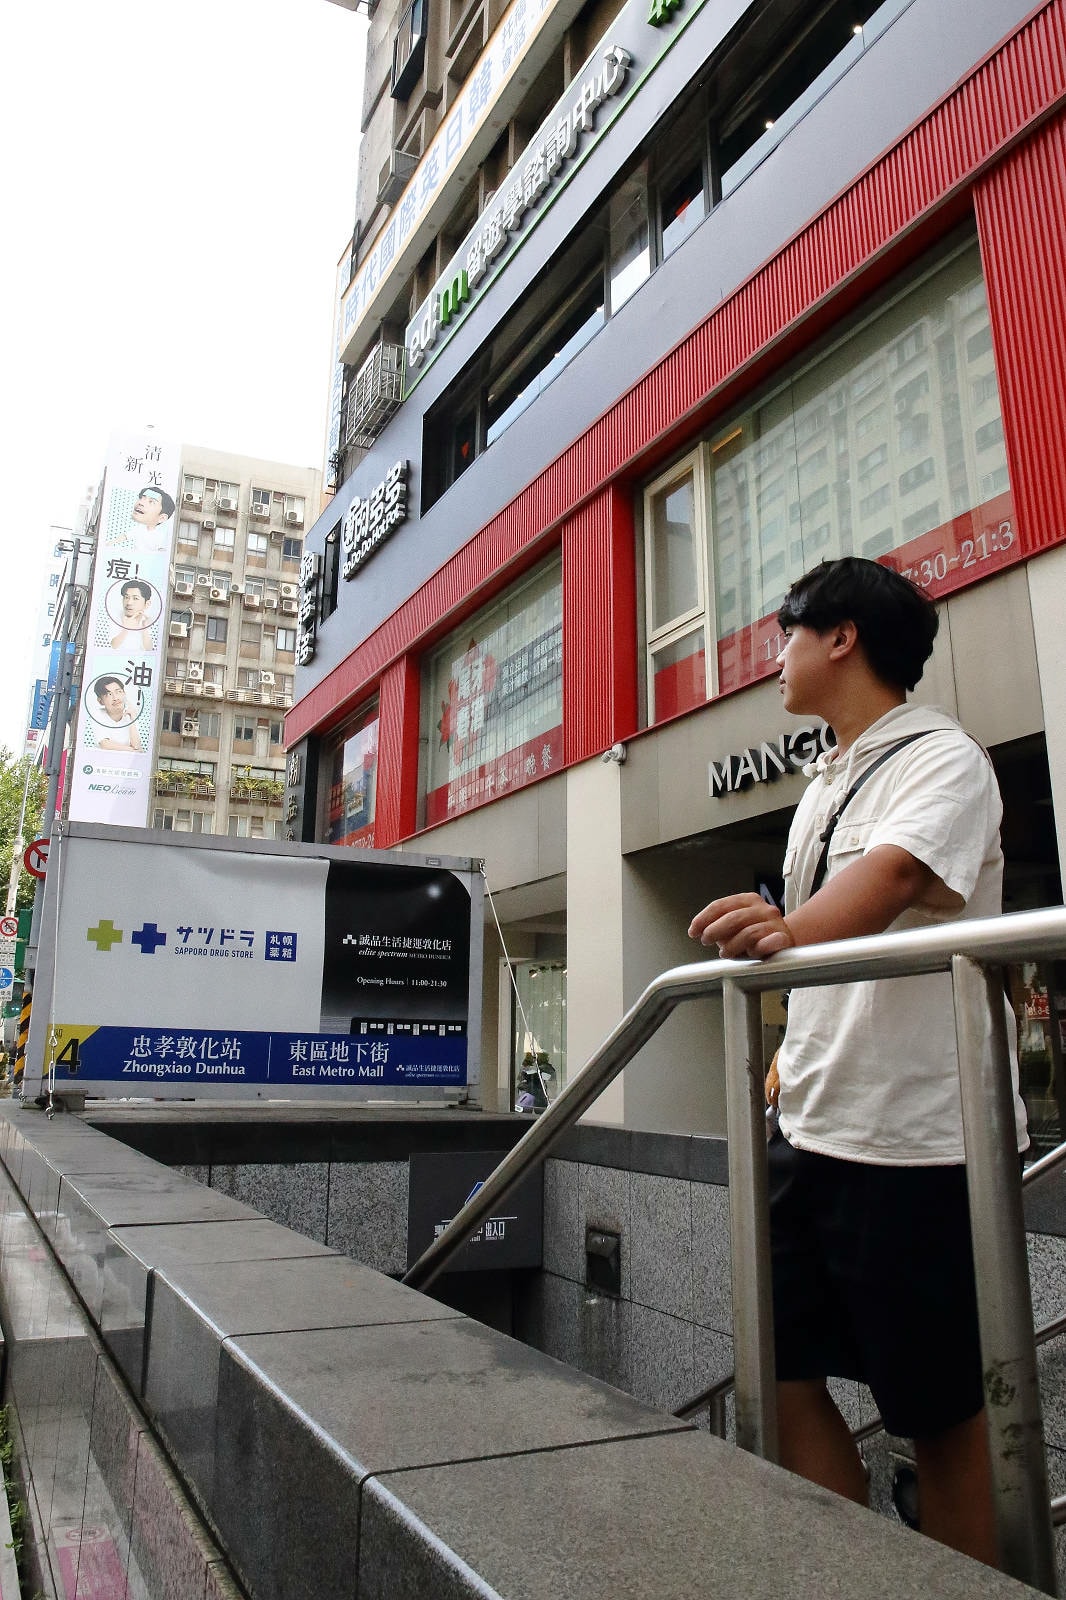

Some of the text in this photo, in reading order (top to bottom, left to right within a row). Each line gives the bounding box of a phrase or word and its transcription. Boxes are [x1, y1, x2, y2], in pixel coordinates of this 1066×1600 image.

[176, 926, 255, 947] サツドラ
[359, 934, 452, 951] 誠品生活捷運敦化店
[174, 946, 254, 959] SAPPORO DRUG STORE
[358, 948, 377, 956] eslite
[377, 949, 409, 959] spectrum
[357, 976, 448, 987] Opening Hours 11:00-21:30
[55, 1038, 81, 1073] 4
[129, 1034, 242, 1061] 忠孝敦化站
[287, 1039, 390, 1064] 東區地下街
[122, 1060, 247, 1077] Zhongxiao Dunhua
[291, 1064, 384, 1077] East Metro Mall
